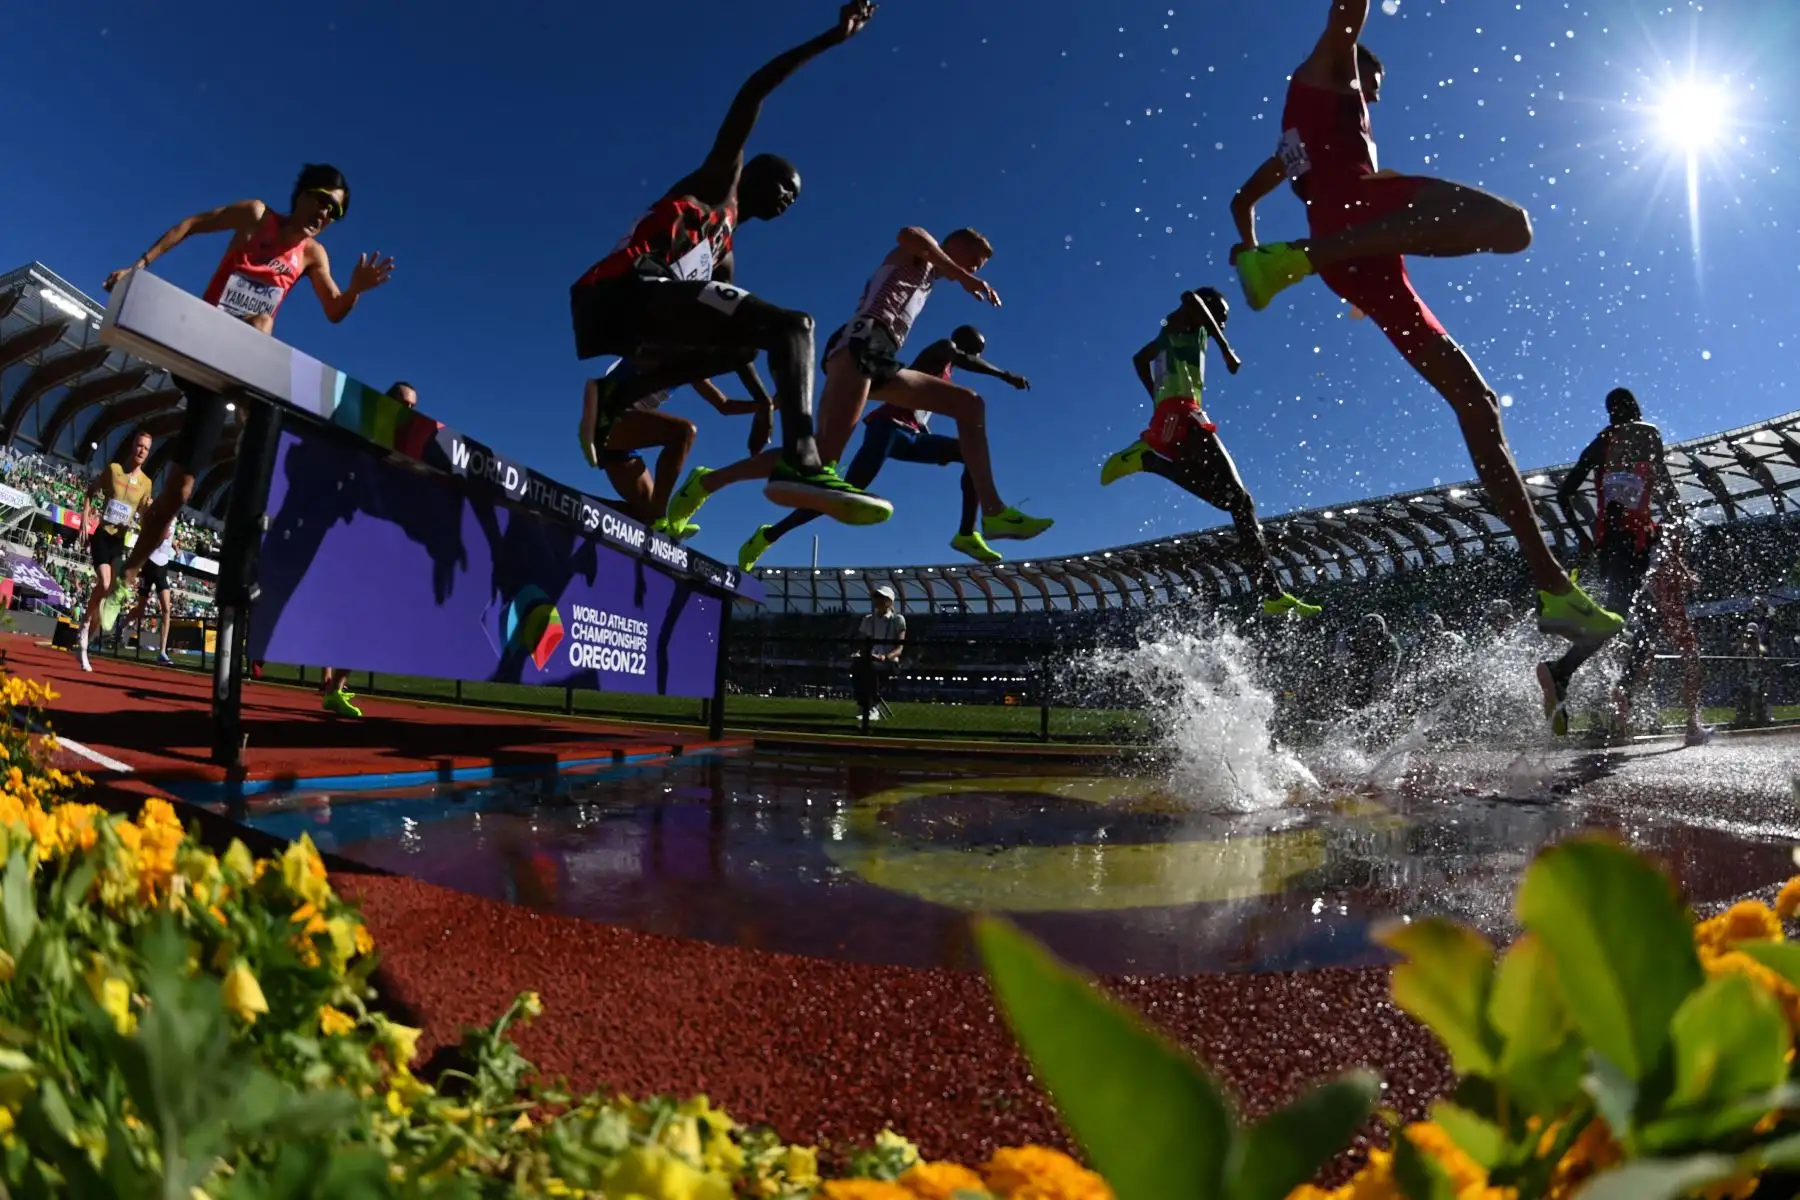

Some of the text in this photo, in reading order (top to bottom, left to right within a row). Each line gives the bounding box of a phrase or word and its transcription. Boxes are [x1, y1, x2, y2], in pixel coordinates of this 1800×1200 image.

[225, 288, 274, 314] YAMAGUCHI
[452, 439, 519, 491] WORLD
[520, 478, 600, 529] ATHLETICS
[602, 514, 688, 568] CHAMPIONSHIPS
[571, 622, 647, 652] CHAMPIONSHIPS
[573, 604, 648, 637] WORLD ATHLETICS
[569, 642, 646, 675] OREGON22
